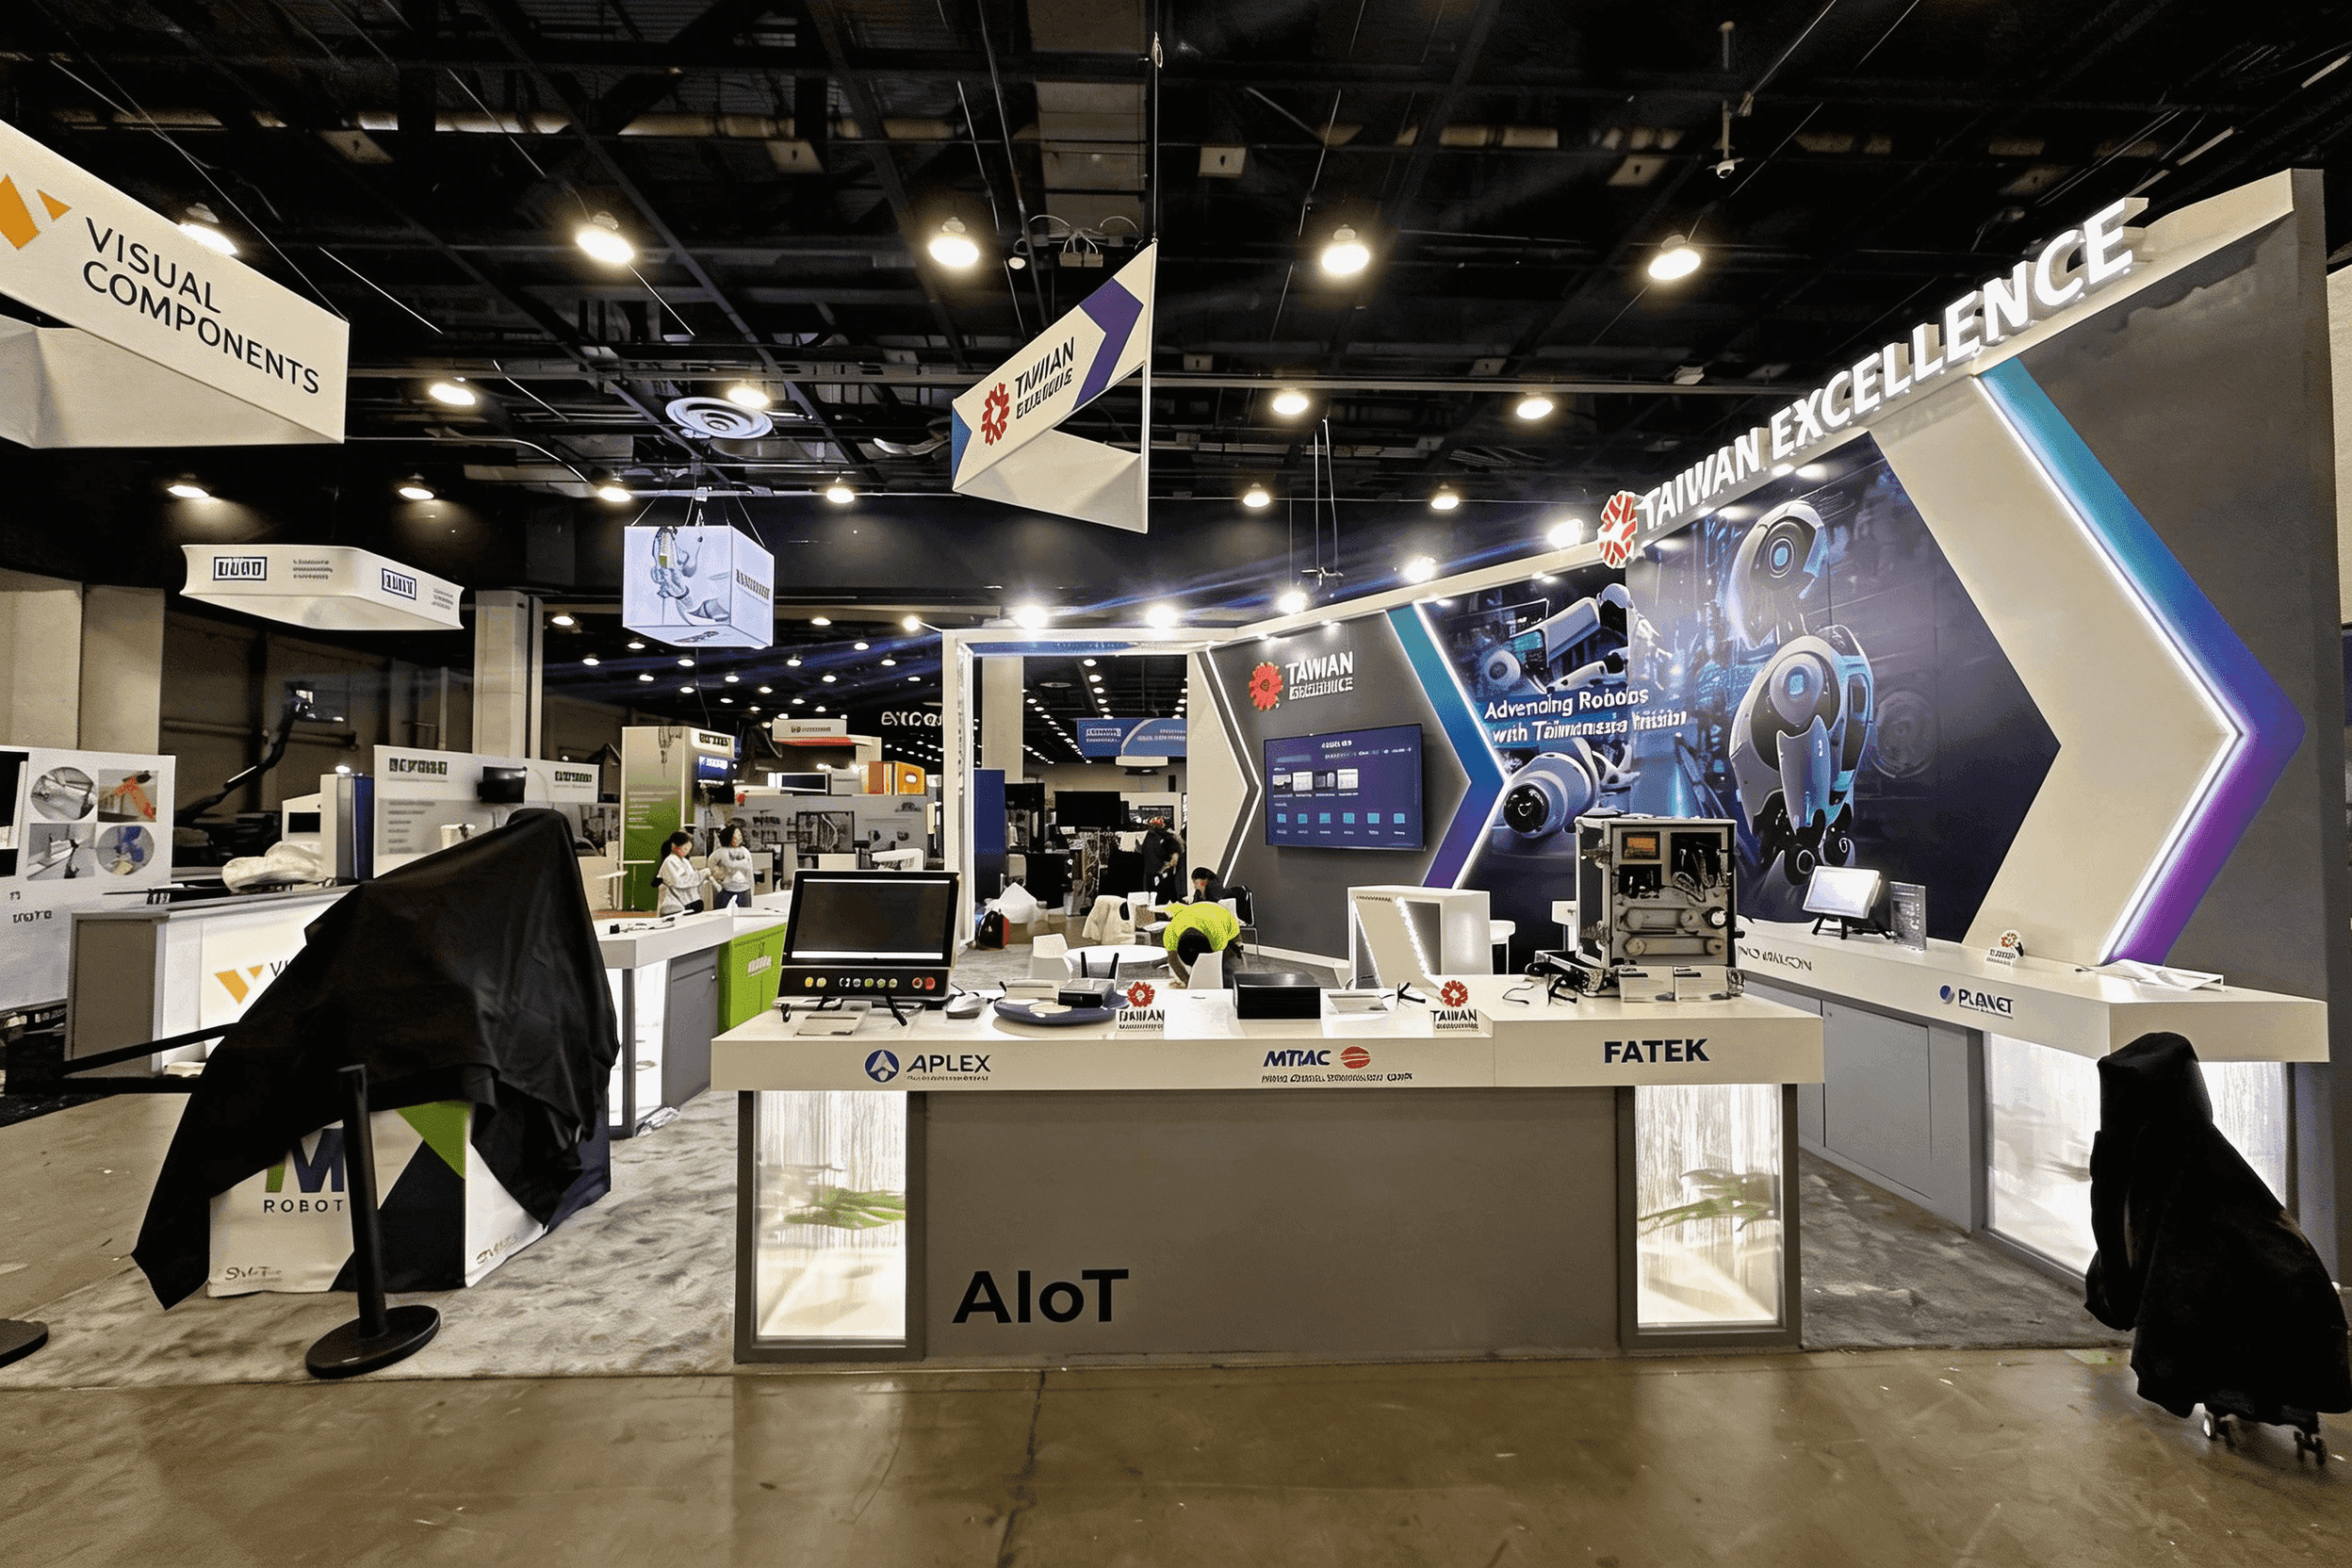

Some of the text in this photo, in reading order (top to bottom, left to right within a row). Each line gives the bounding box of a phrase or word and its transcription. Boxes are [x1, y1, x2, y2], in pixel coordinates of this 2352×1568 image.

[86, 217, 221, 314] VISUAL
[83, 260, 319, 394] COMPONENTS
[1634, 198, 2135, 530] TAIWAN EXCELLENCE
[906, 1054, 991, 1073] APLEX
[1604, 1037, 1710, 1064] FATEK
[264, 1199, 344, 1214] ROBOT
